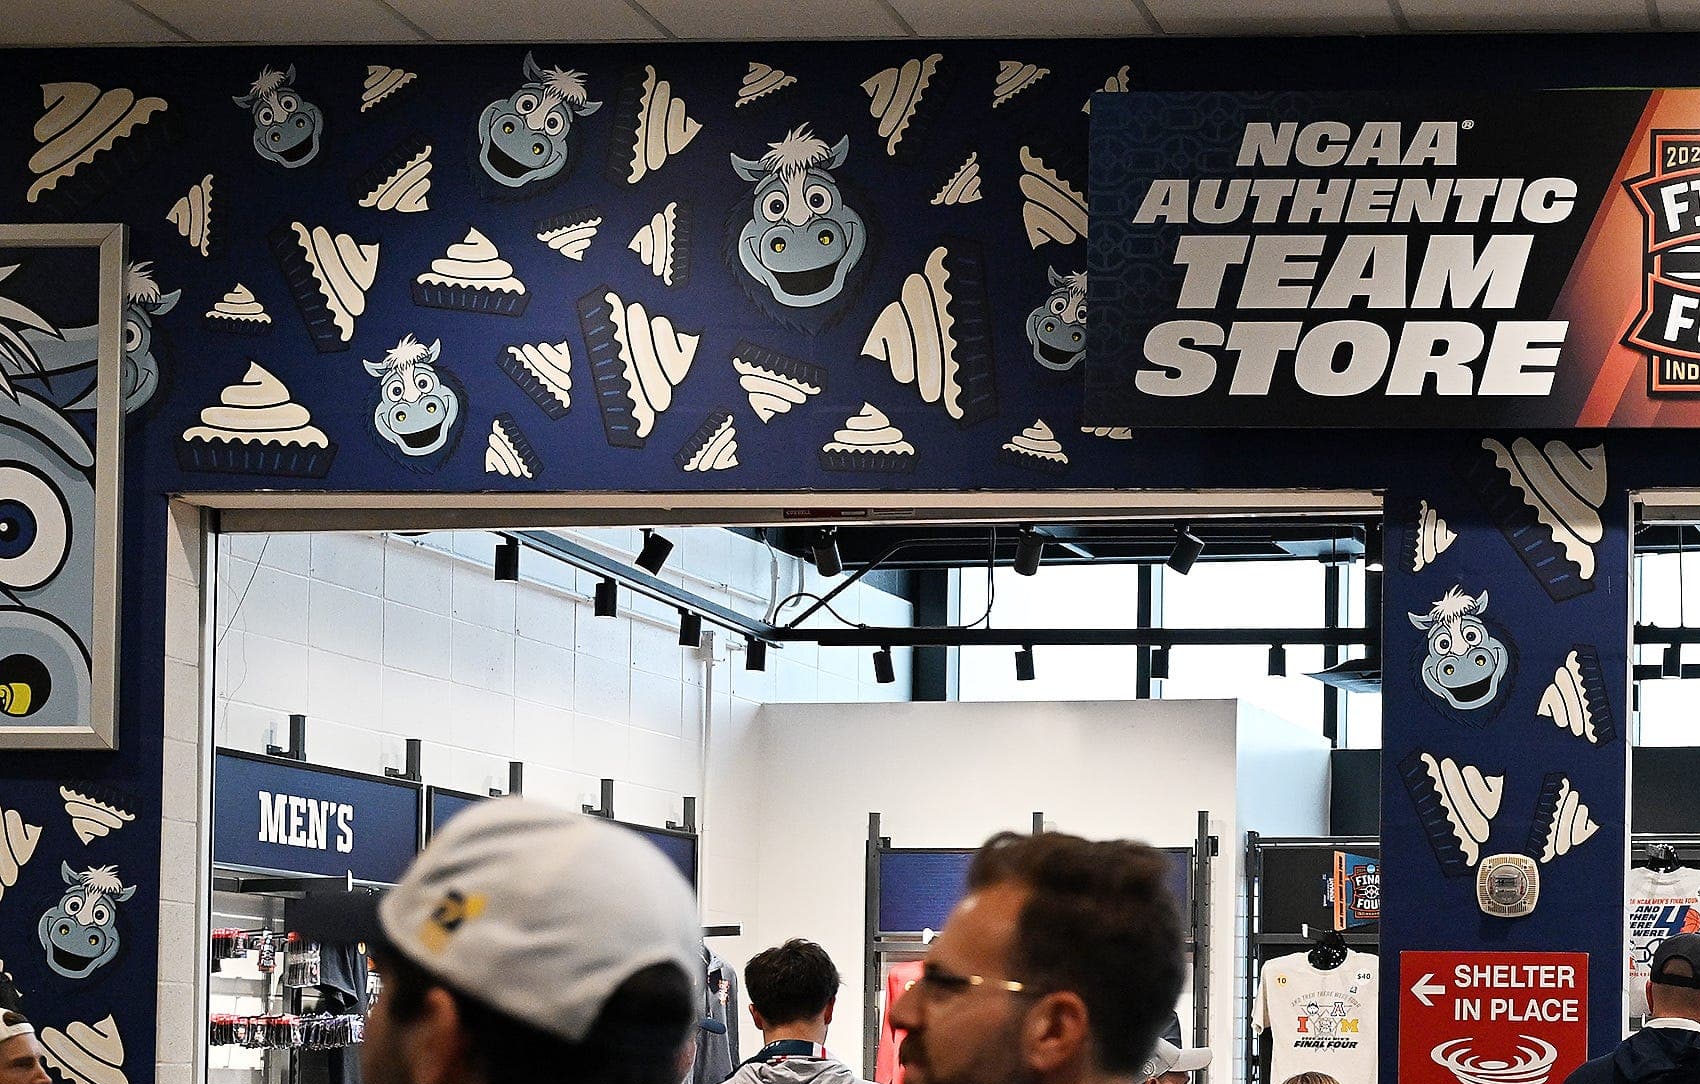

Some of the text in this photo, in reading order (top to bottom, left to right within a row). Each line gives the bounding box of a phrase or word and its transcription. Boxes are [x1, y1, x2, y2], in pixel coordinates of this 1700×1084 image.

[1132, 177, 1576, 225] AUTHENTIC
[1173, 234, 1535, 310] TEAM
[1135, 320, 1570, 398] STORE
[258, 790, 354, 853] MEN'S
[1355, 874, 1380, 886] FINA
[1357, 898, 1380, 910] FOU
[1630, 921, 1653, 929] ERE
[1632, 929, 1664, 937] WERE
[1653, 905, 1691, 937] 4
[1454, 964, 1576, 989] SHELTER
[1454, 998, 1579, 1022] IN PLACE
[1340, 1018, 1359, 1033] M
[1294, 1040, 1325, 1048] FINAL
